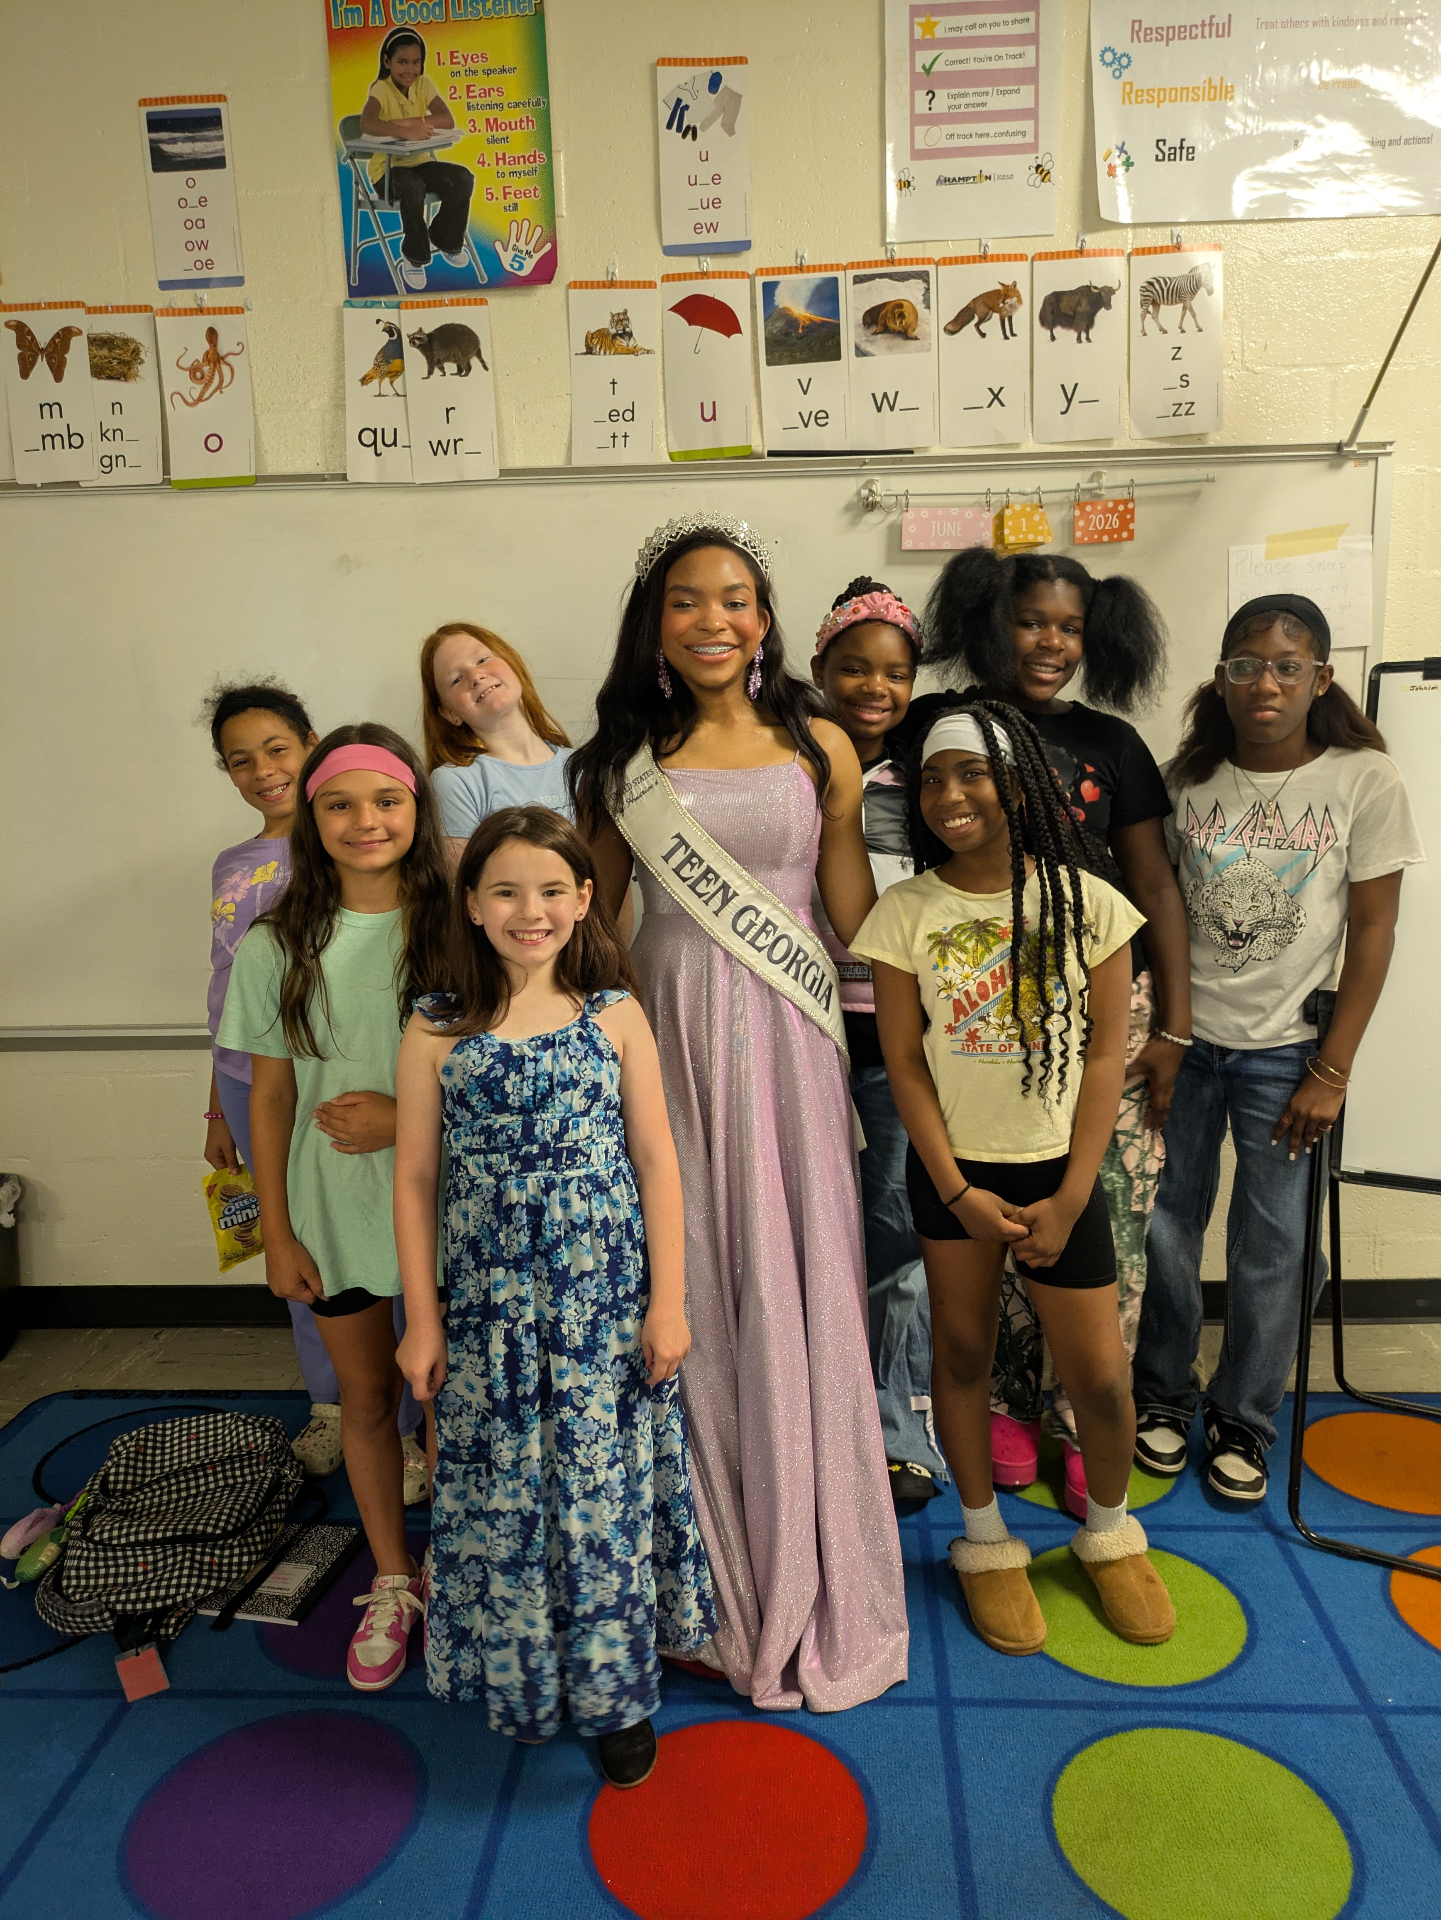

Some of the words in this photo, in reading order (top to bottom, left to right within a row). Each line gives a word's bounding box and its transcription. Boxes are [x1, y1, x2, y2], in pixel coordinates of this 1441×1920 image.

[331, 0, 364, 28] I'm
[369, 0, 386, 26] A
[391, 0, 445, 25] Good
[451, 0, 540, 19] Listener
[1256, 17, 1278, 30] Treat
[1281, 17, 1309, 29] others
[1312, 16, 1330, 28] with
[1332, 15, 1369, 27] kindness
[1372, 14, 1388, 27] and
[948, 25, 963, 34] may
[965, 23, 977, 31] call
[988, 20, 1001, 30] you
[1002, 18, 1010, 26] to
[1011, 16, 1030, 26] share
[1130, 13, 1232, 47] Respectful
[436, 52, 446, 66] 1.
[449, 50, 489, 67] Eyes
[944, 57, 971, 67] Correct!
[972, 54, 992, 64] You're
[994, 54, 1004, 62] On
[1005, 52, 1026, 61] Track!
[450, 69, 461, 78] on
[464, 67, 479, 77] the
[481, 65, 518, 78] speaker
[449, 86, 462, 100] 2.
[466, 84, 505, 100] Ears
[947, 91, 970, 102] Explain
[972, 90, 990, 98] more
[996, 87, 1020, 96] Expand
[1122, 76, 1235, 109] Responsible
[466, 100, 504, 112] listening
[507, 98, 548, 110] carefully
[947, 103, 962, 112] your
[964, 101, 988, 110] answer
[468, 118, 482, 134] 3.
[485, 115, 535, 132] Mouth
[486, 135, 510, 145] silent
[946, 132, 956, 140] Off
[956, 131, 973, 140] track
[1388, 135, 1402, 146] and
[1404, 134, 1434, 146] actions!
[699, 150, 709, 162] u
[1155, 138, 1196, 162] Safe
[477, 153, 491, 168] 4.
[495, 150, 546, 167] Hands
[496, 171, 506, 179] to
[508, 167, 539, 180] myself
[485, 187, 499, 202] 5.
[502, 185, 540, 200] Feet
[503, 203, 518, 213] still
[184, 218, 206, 230] oa
[693, 221, 720, 234] ew
[184, 239, 209, 252] ow
[512, 244, 524, 254] Give
[524, 249, 534, 260] Me
[509, 254, 527, 272] 5
[1171, 346, 1182, 361] z
[610, 378, 618, 396] t
[797, 378, 812, 396] v
[39, 402, 63, 420] m
[111, 401, 123, 416] n
[445, 406, 456, 424] r
[700, 400, 717, 422] u
[204, 433, 224, 453] o
[930, 520, 963, 538] JUNE
[1020, 518, 1028, 532] 1
[1088, 513, 1120, 531] 2026
[1235, 549, 1290, 576] Please
[632, 768, 654, 787] STATES
[1184, 797, 1226, 863] DEF
[1220, 800, 1338, 870] LEPPARD
[661, 832, 740, 918] TEEN
[730, 904, 834, 1014] GEORGIA
[960, 1042, 992, 1053] STATE
[998, 1043, 1014, 1053] OF
[224, 1196, 258, 1215] OREO
